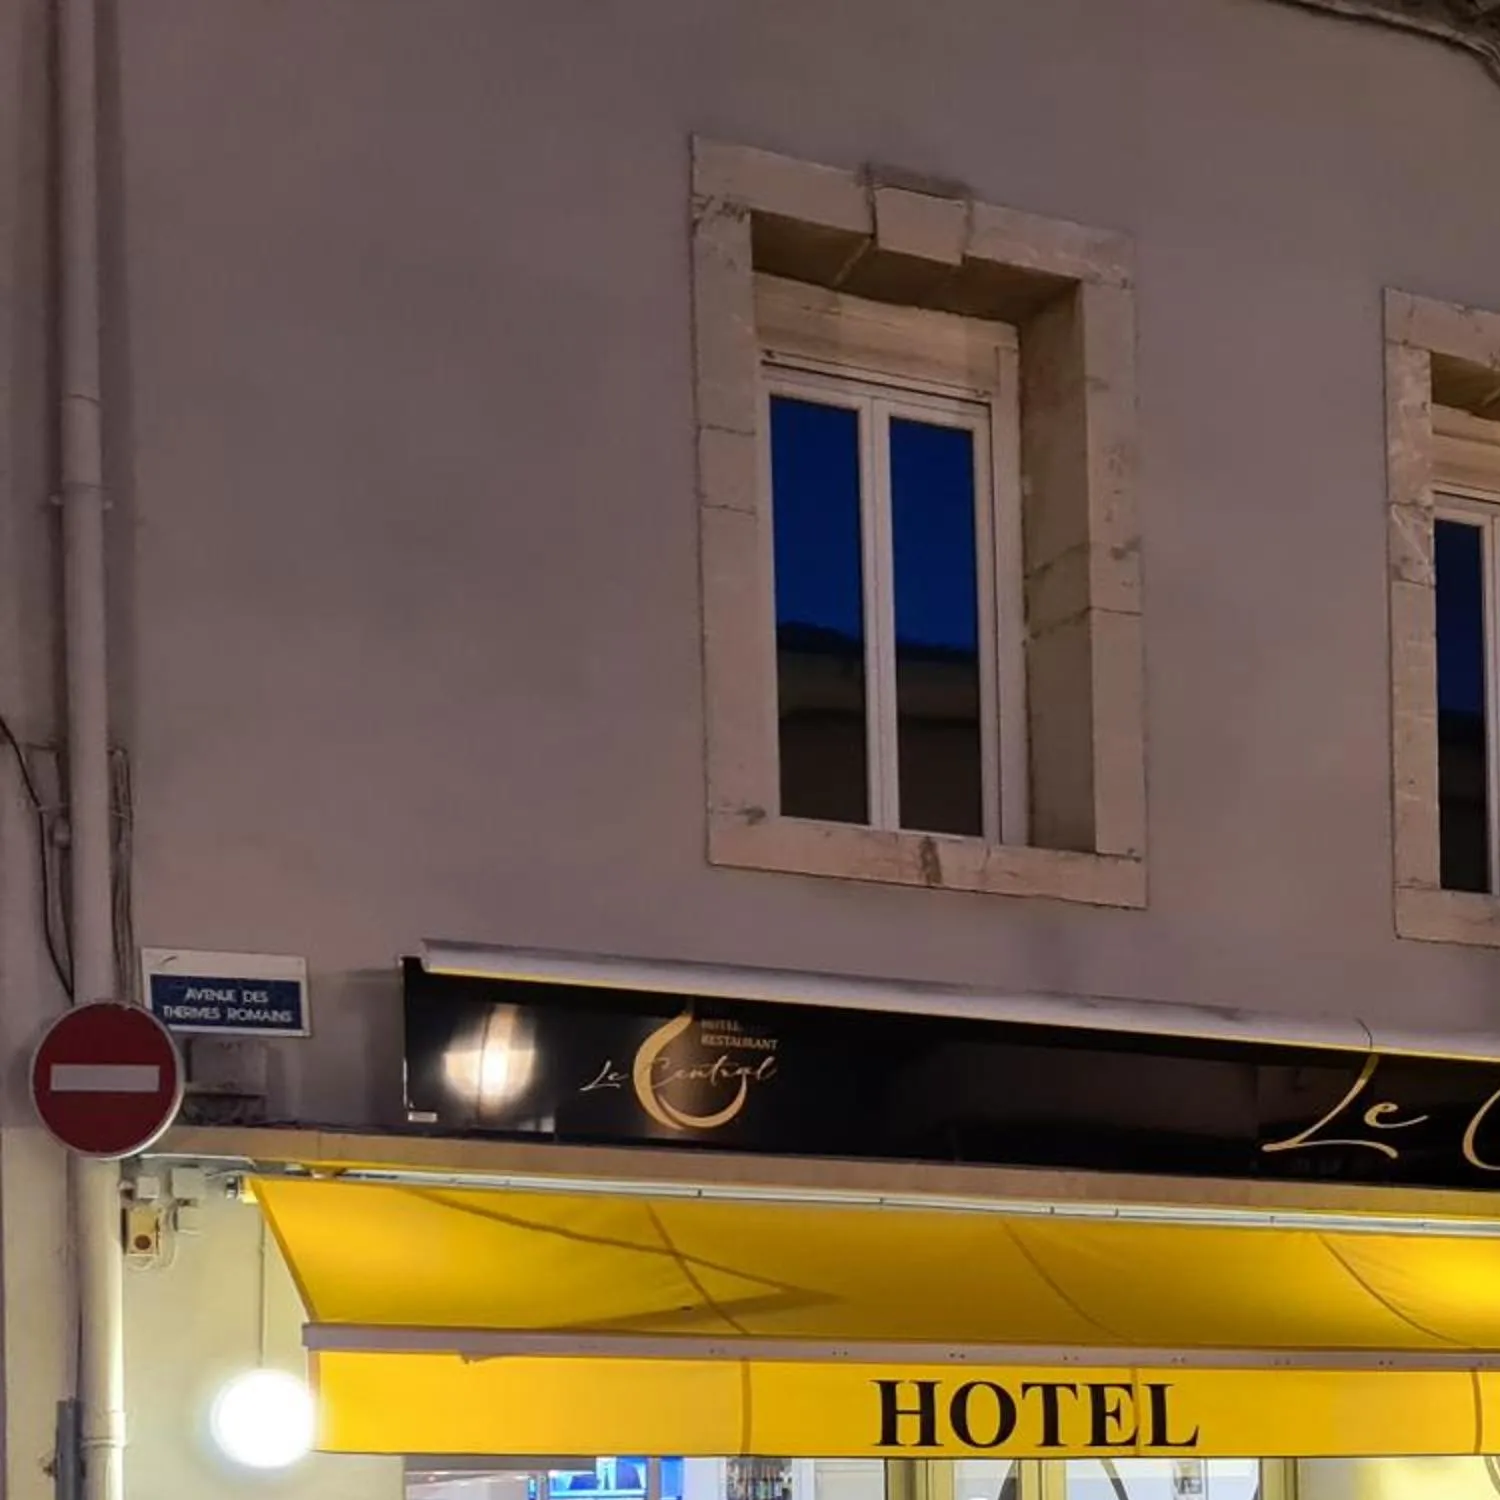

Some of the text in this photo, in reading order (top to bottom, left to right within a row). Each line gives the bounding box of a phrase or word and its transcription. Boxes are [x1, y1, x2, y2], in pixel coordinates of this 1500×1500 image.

[185, 986, 269, 1004] AVENUE DES
[162, 1004, 293, 1023] THERMES ROMAINS
[701, 1033, 779, 1051] RESTAURANT
[579, 1060, 630, 1091] Le
[1261, 1053, 1430, 1159] Le
[870, 1379, 1200, 1448] HOTEL
